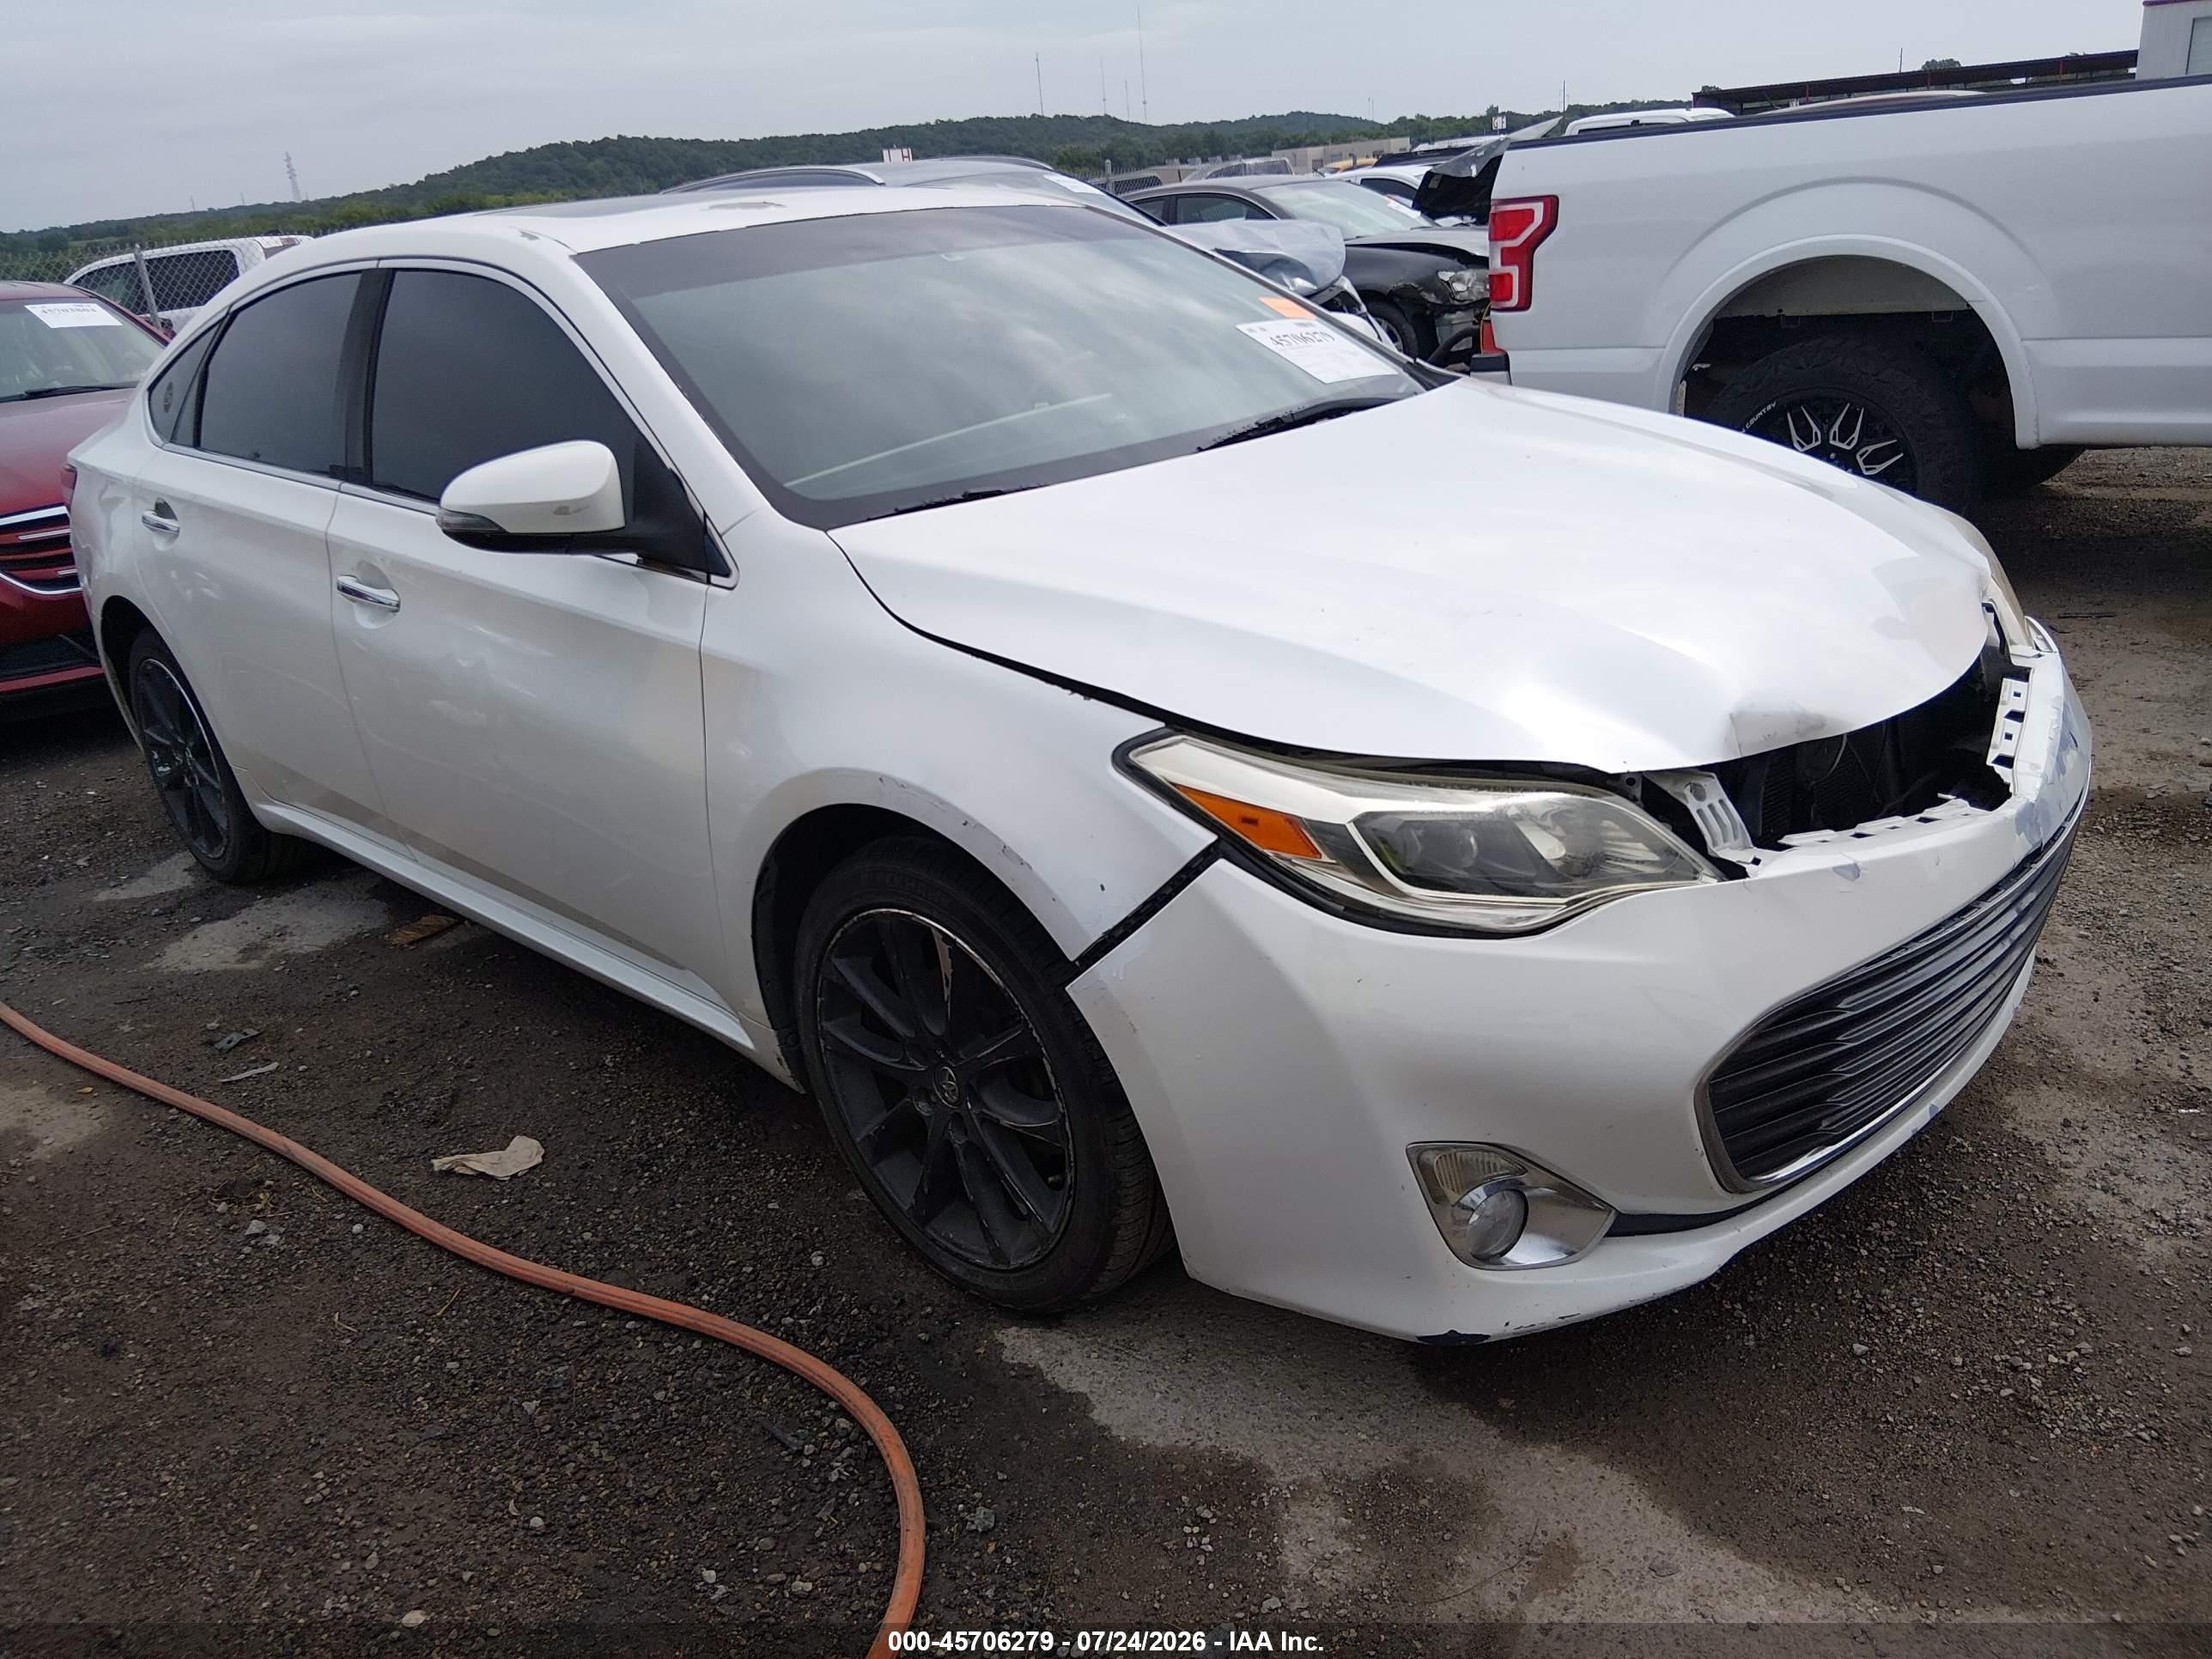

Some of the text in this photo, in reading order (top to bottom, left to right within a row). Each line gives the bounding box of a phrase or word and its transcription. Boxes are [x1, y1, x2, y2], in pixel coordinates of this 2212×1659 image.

[901, 147, 911, 162] H
[1269, 331, 1336, 348] 45706279
[1745, 400, 1777, 429] COUNTRY
